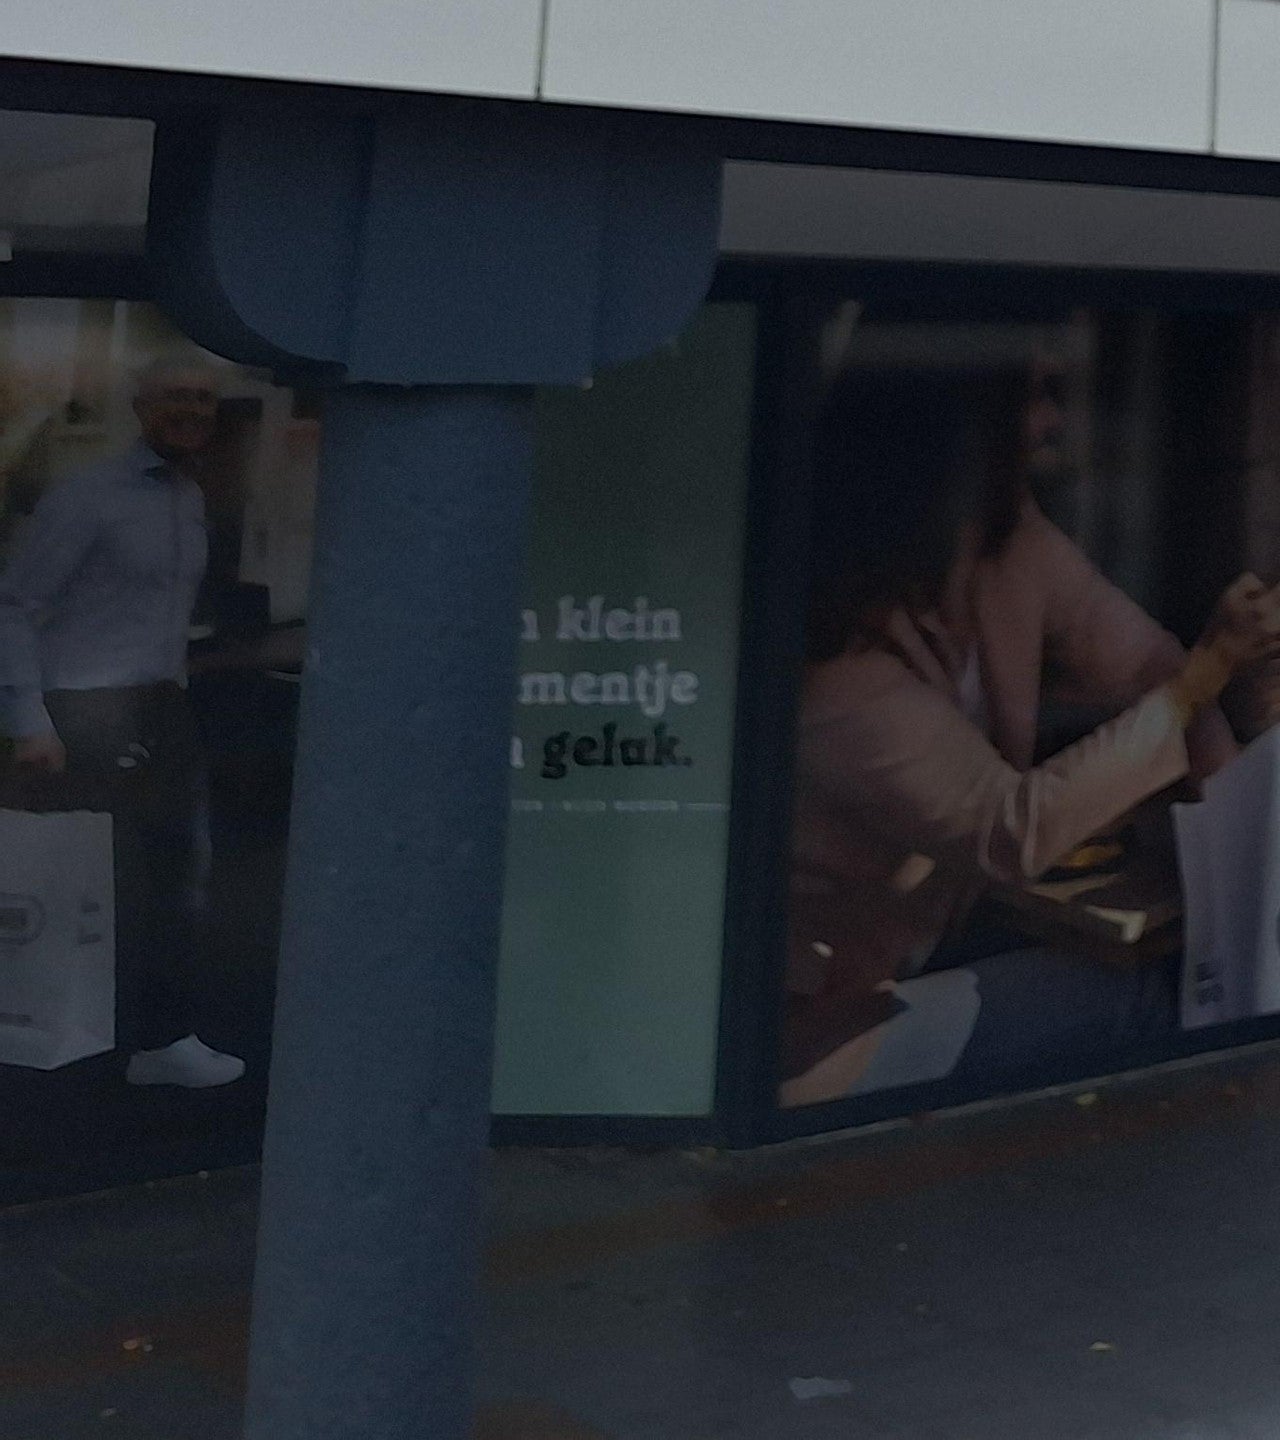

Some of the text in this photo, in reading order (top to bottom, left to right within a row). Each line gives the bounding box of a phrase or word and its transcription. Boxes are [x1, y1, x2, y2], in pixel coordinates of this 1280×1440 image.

[556, 594, 682, 641] klein
[518, 660, 700, 717] mentje
[540, 721, 694, 780] geluk.
